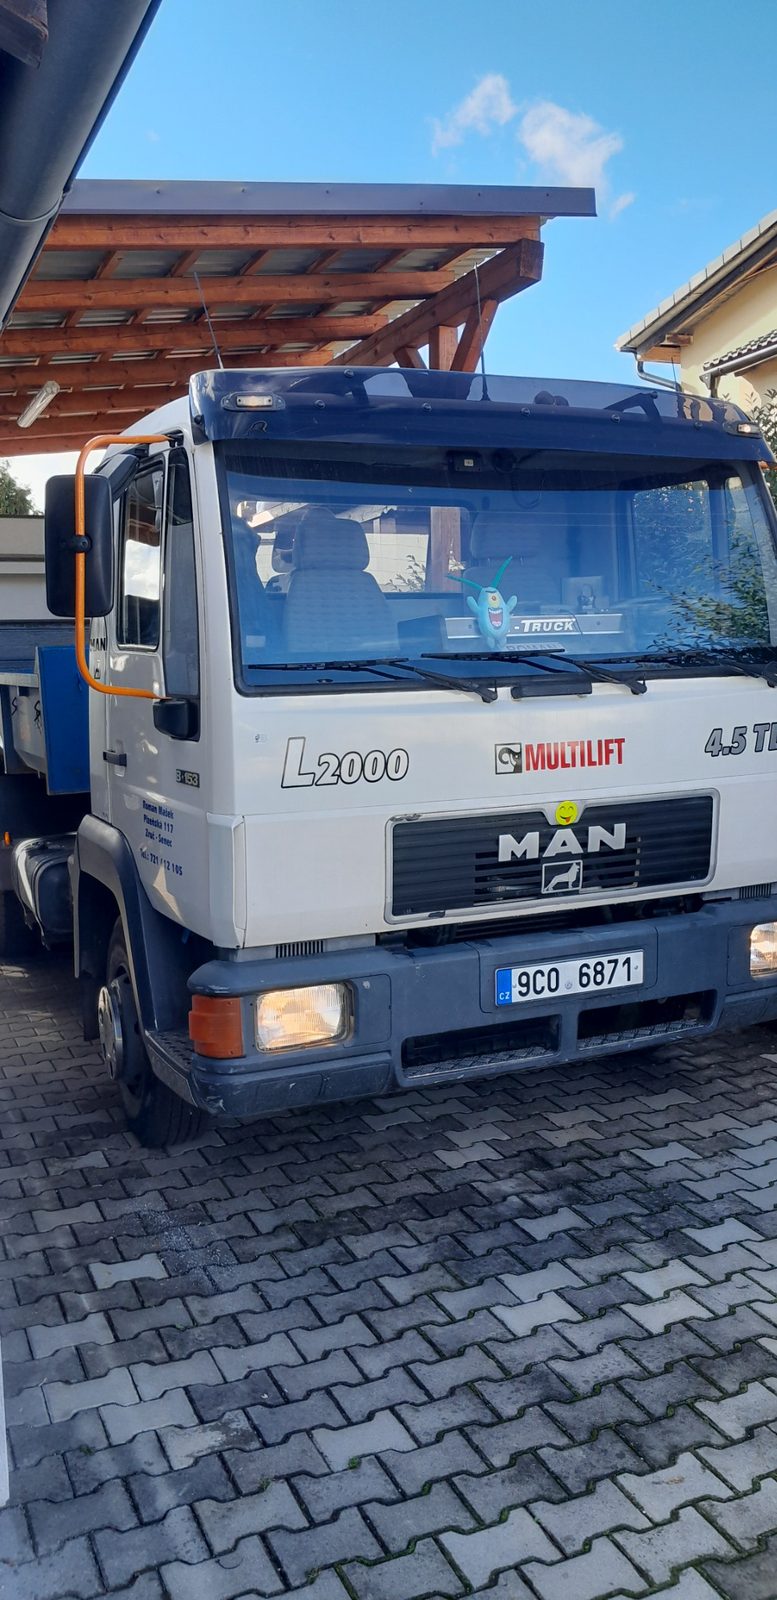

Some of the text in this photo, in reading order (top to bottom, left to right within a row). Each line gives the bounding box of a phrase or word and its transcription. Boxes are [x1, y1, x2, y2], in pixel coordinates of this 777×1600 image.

[525, 738, 625, 771] MULTILIFT
[704, 726, 748, 757] 4.5
[281, 736, 409, 788] L2000
[143, 800, 157, 814] Roman
[164, 821, 174, 834] 117
[498, 823, 626, 862] MAN
[150, 853, 159, 865] 721
[172, 863, 183, 876] 105
[578, 956, 631, 988] 6871
[499, 992, 510, 1001] CZ
